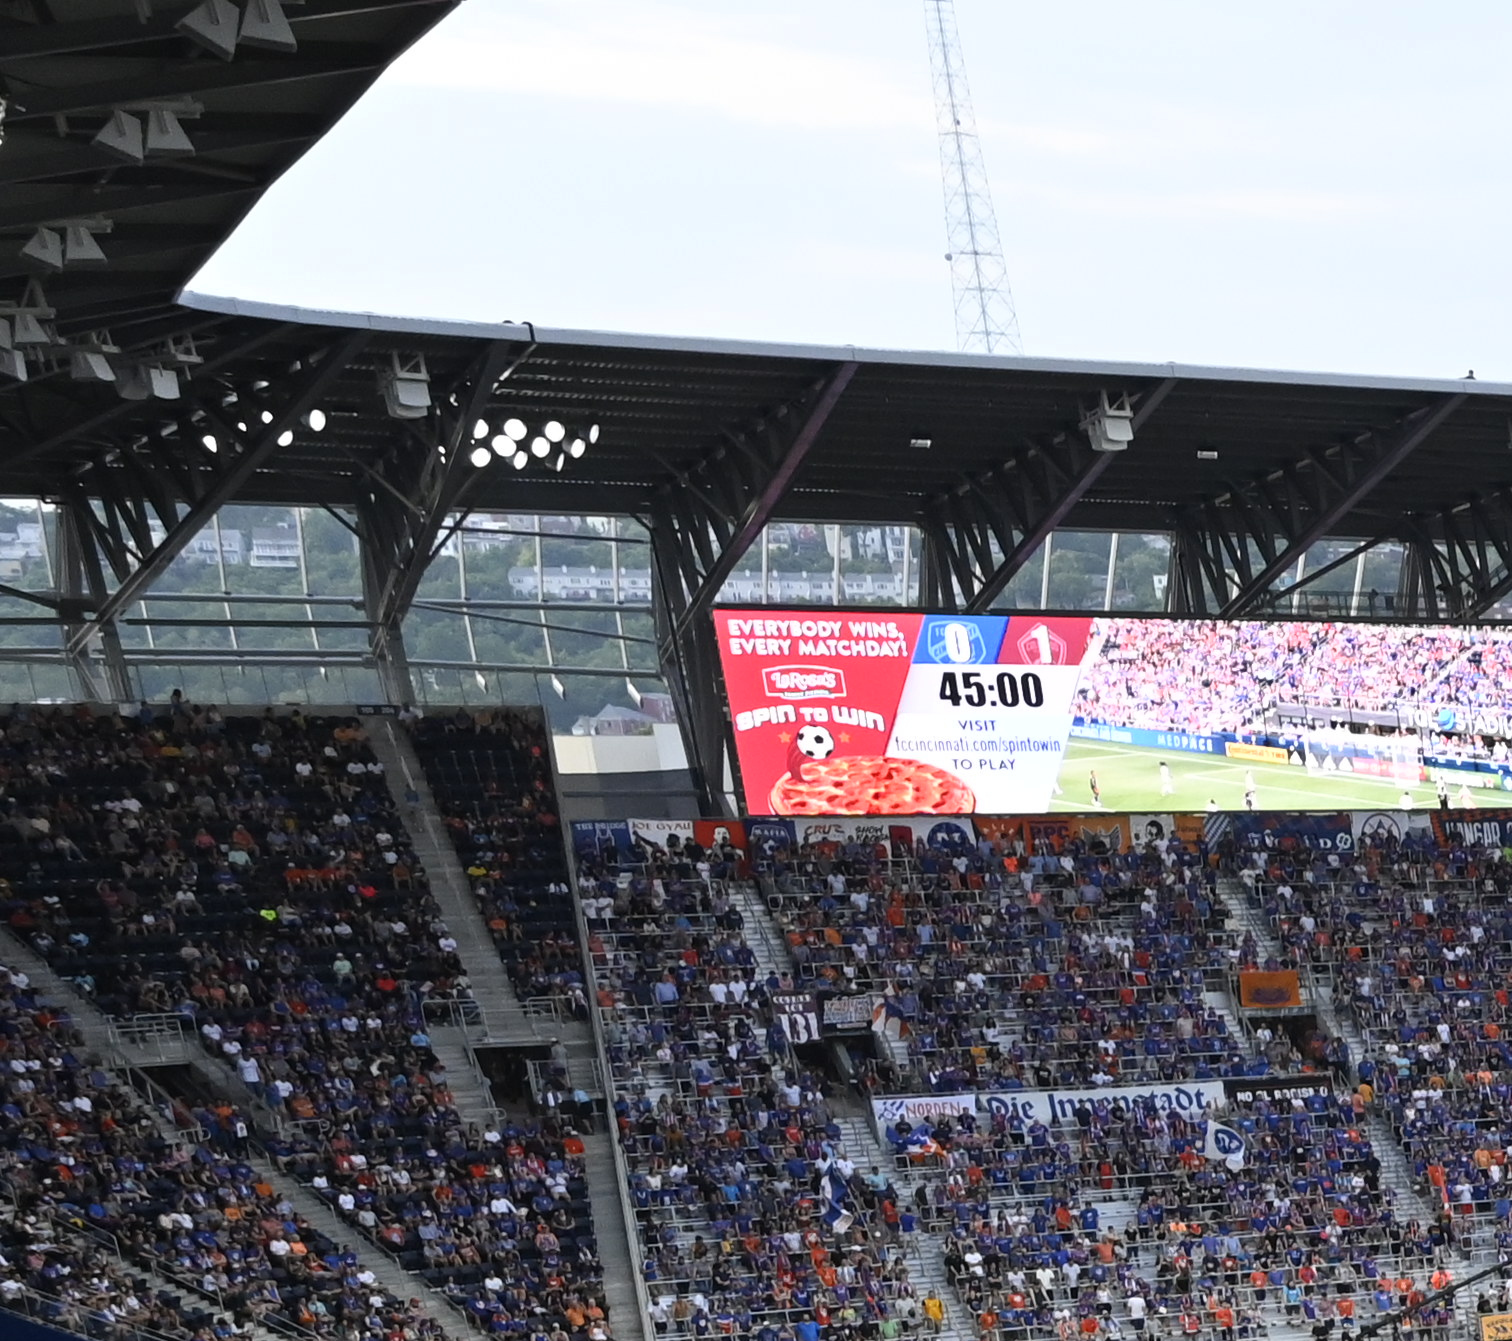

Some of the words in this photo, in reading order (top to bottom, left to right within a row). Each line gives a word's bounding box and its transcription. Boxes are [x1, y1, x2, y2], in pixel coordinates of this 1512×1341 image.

[727, 619, 842, 638] EVERYBODY
[848, 621, 905, 641] WINS,
[729, 638, 791, 655] EVERY
[799, 640, 908, 657] MATCHDAY!
[944, 623, 971, 663] 0
[1031, 625, 1052, 664] 1
[939, 672, 1044, 707] 45:00
[735, 705, 796, 731] SPIN
[800, 707, 829, 722] TO
[831, 705, 886, 731] WIN
[958, 720, 996, 731] VISIT
[896, 736, 1061, 755] fccincinnati.com/spintowin
[1157, 734, 1212, 752] MEDPACE
[952, 759, 973, 770] TO
[979, 759, 1016, 770] PLAY
